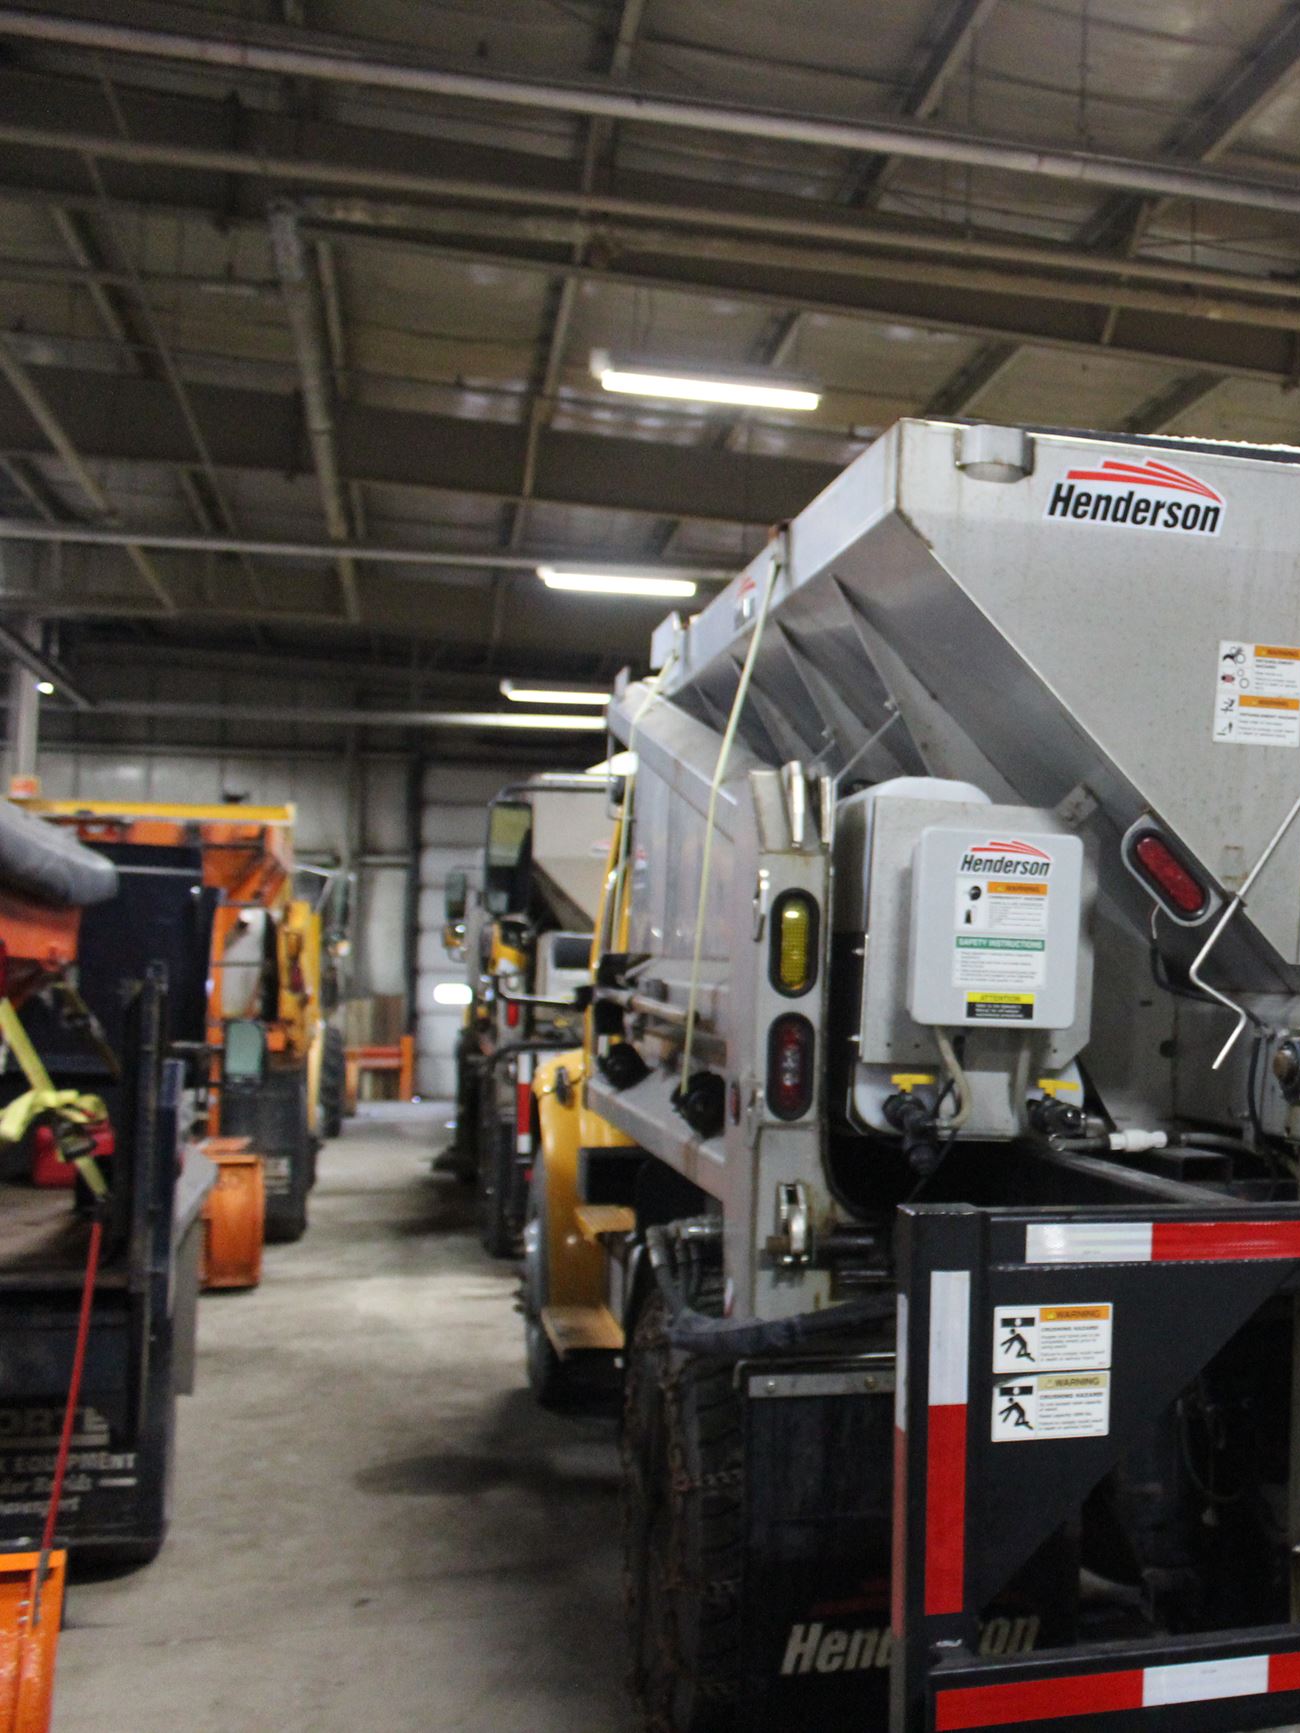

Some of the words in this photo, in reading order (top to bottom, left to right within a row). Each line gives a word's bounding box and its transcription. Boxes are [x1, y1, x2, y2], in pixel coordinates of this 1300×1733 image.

[1046, 482, 1222, 533] Henderson
[960, 854, 1050, 877] Henderson
[1056, 1309, 1101, 1319] WARNING
[1055, 1376, 1100, 1387] WARNING
